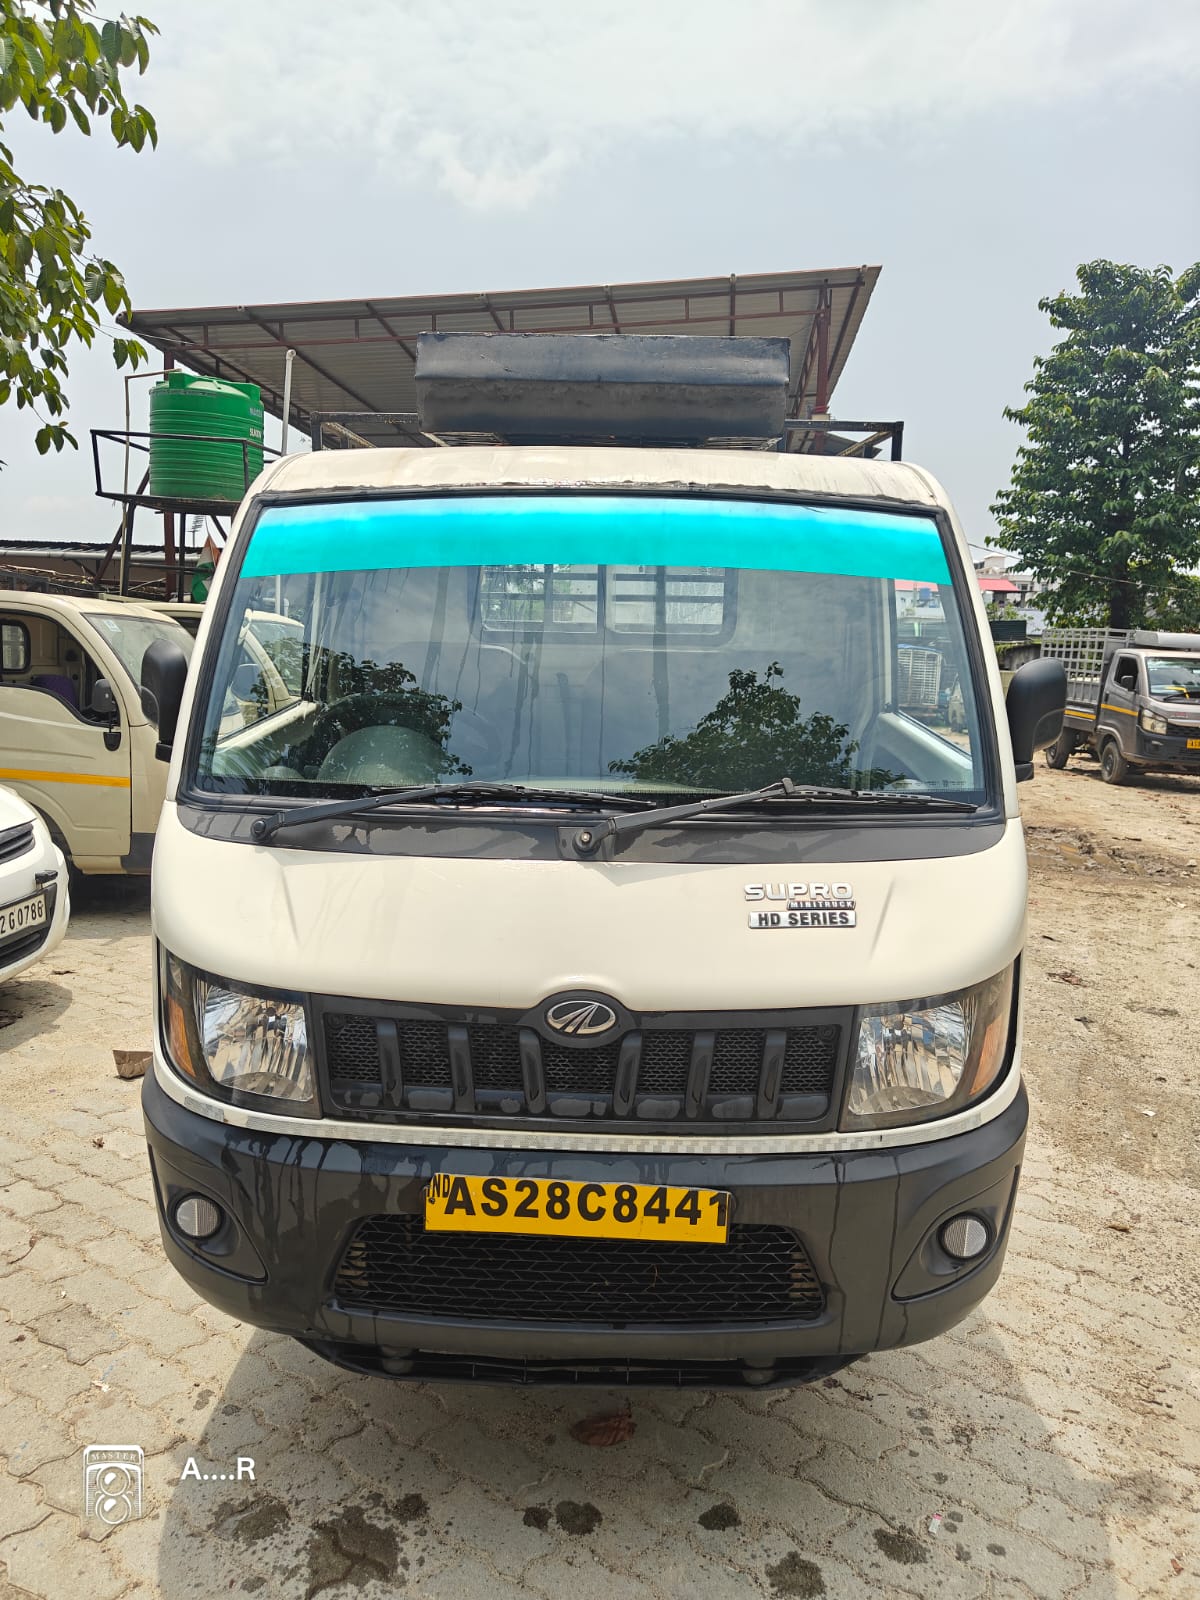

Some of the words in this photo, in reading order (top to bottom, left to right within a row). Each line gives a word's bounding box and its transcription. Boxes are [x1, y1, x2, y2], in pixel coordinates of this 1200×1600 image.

[744, 883, 853, 900] SUPRO
[758, 913, 780, 926] HD
[788, 912, 849, 925] SERIES
[444, 1177, 727, 1226] AS28C8441
